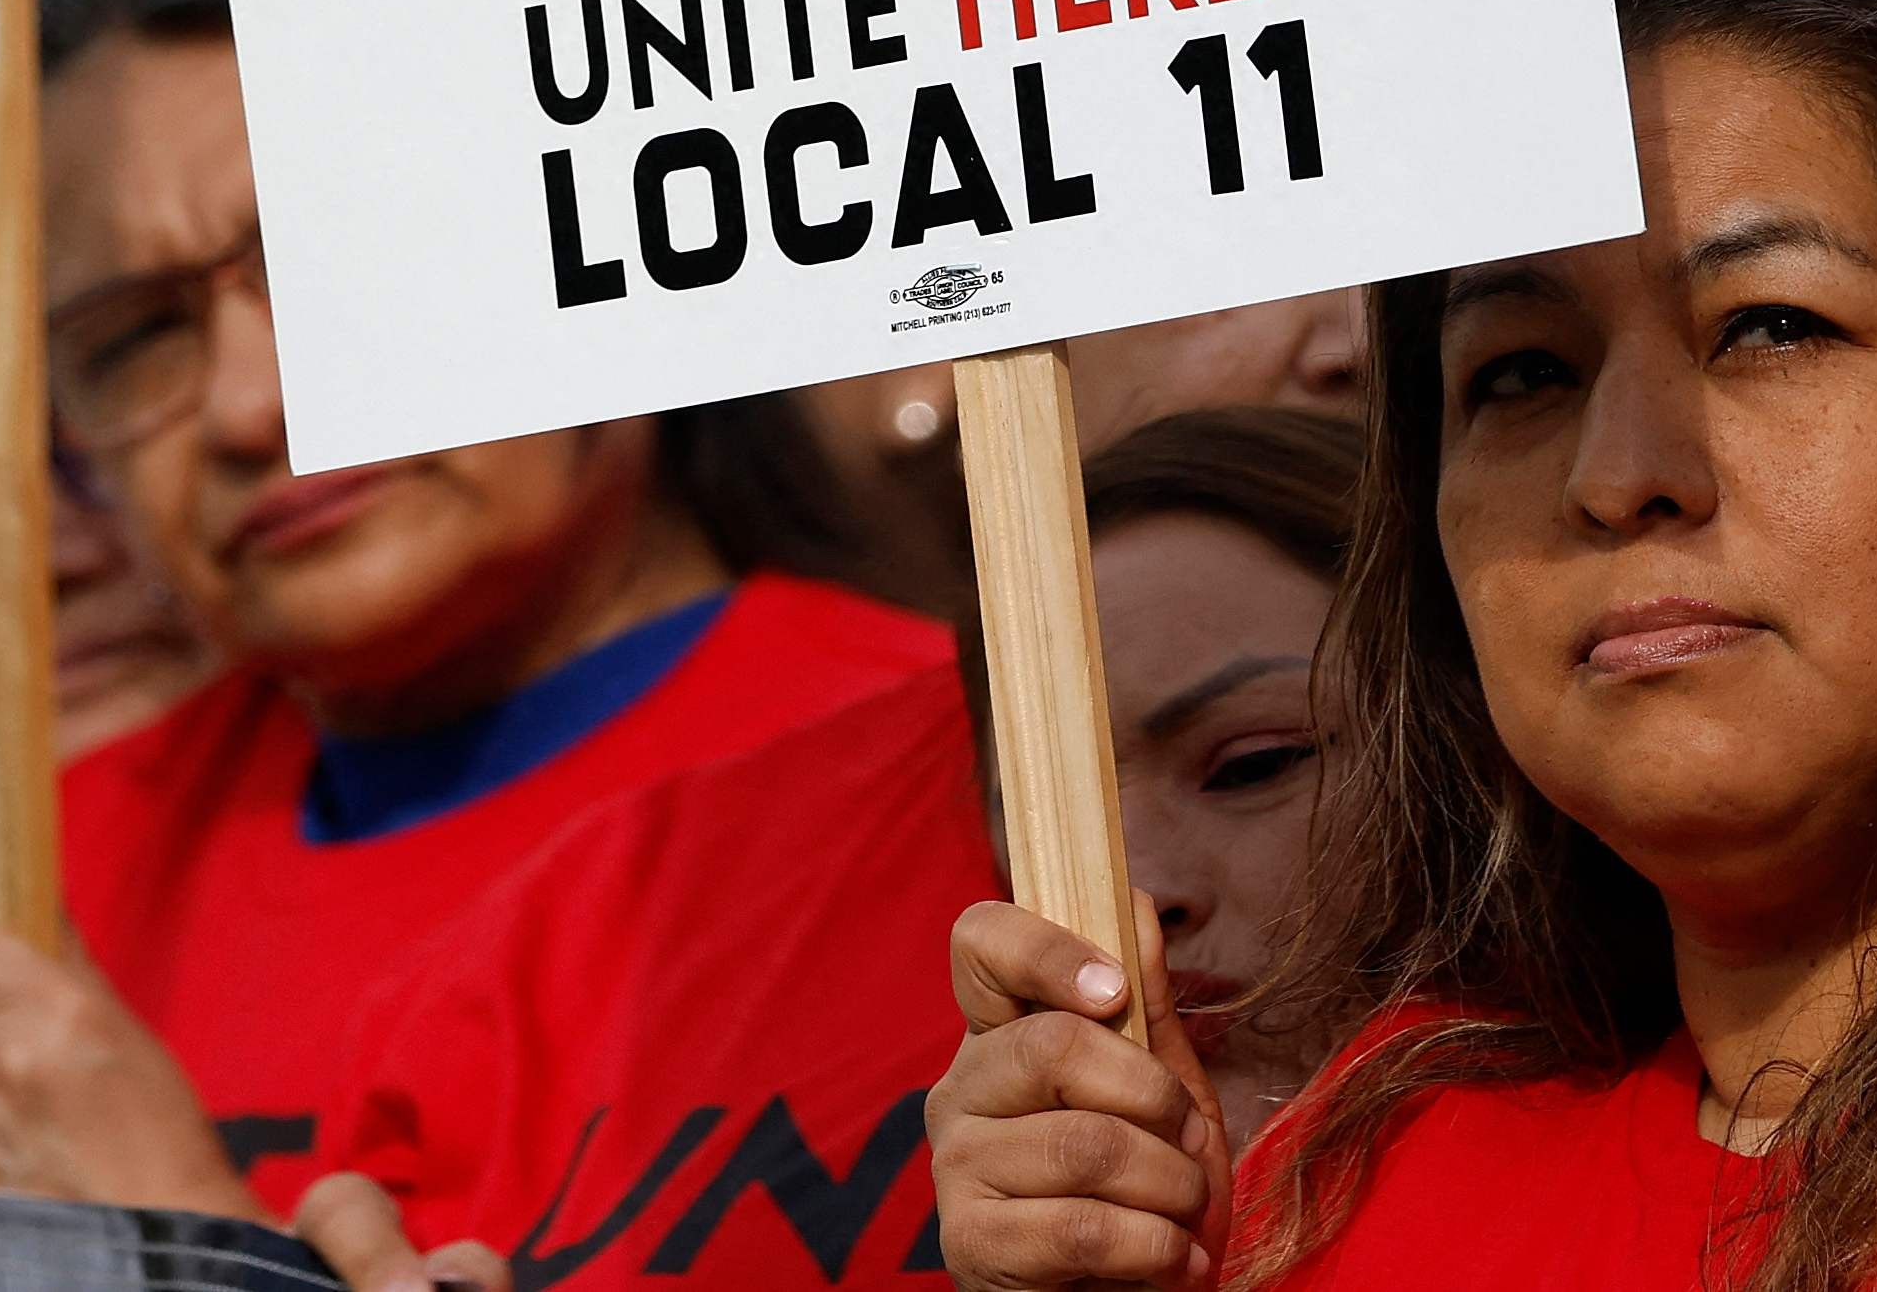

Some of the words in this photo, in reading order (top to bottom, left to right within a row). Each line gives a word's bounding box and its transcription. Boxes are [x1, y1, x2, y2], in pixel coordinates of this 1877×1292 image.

[542, 62, 1096, 309] LOCAL
[1168, 20, 1323, 195] 11
[991, 271, 1004, 284] 65
[891, 317, 927, 332] MITCHELL
[928, 311, 962, 326] PRINTING
[964, 307, 981, 322] (213)
